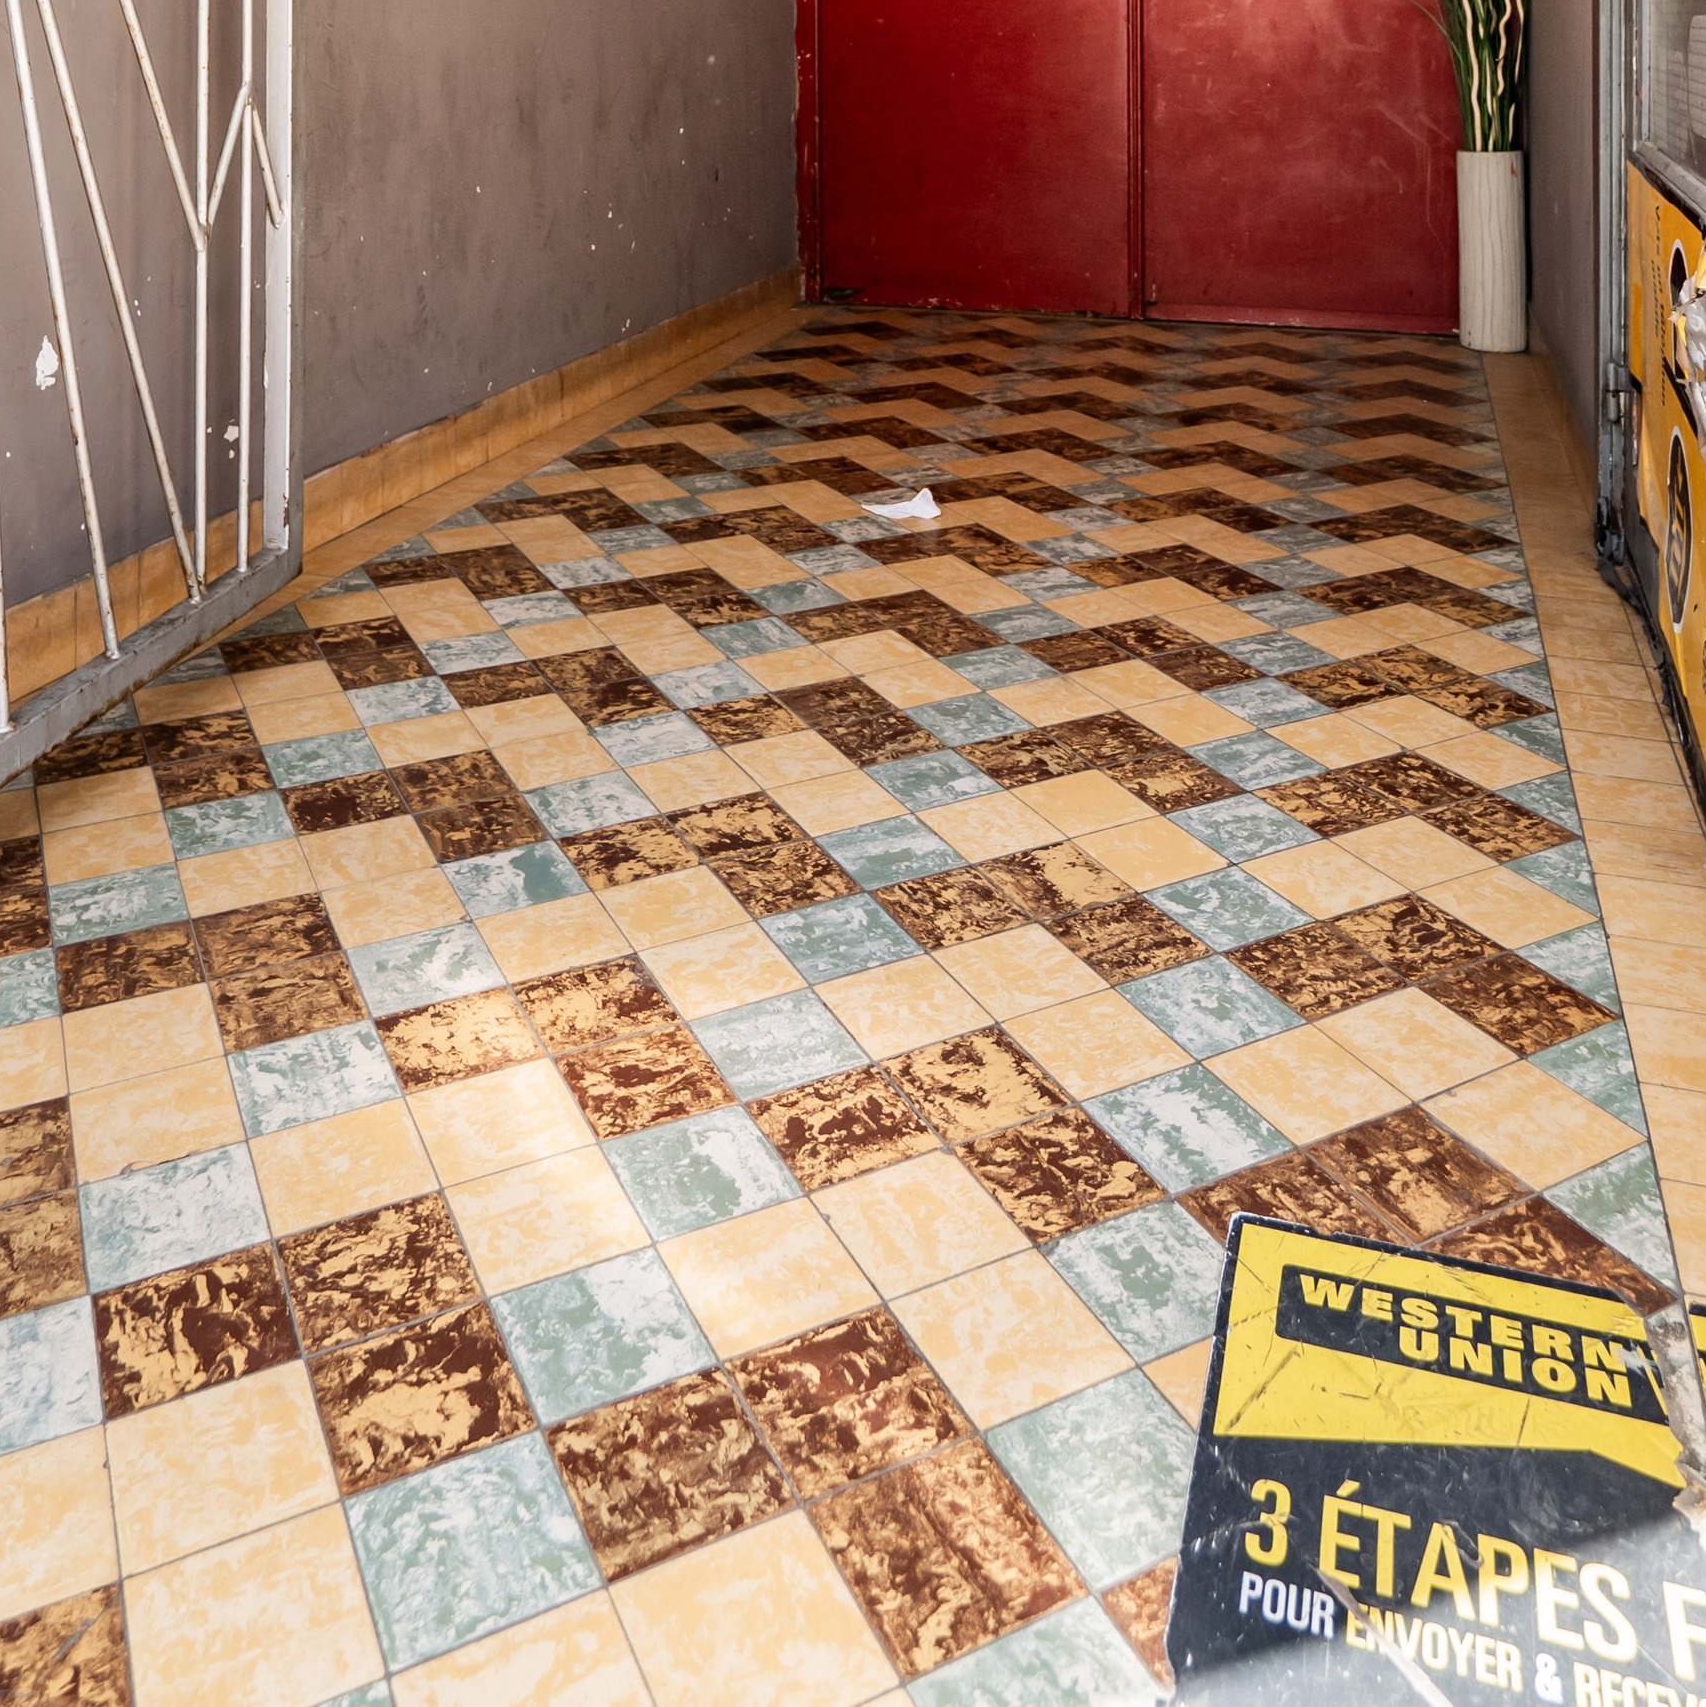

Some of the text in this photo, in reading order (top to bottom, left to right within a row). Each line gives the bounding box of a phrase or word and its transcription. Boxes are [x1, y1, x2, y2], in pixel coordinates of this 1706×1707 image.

[1299, 1274, 1624, 1371] WESTERN
[1399, 1327, 1632, 1408] UNION
[1244, 1479, 1292, 1568] 3
[1318, 1479, 1639, 1664] ÉTAPES
[1238, 1571, 1563, 1703] POUR ENVOYER &
